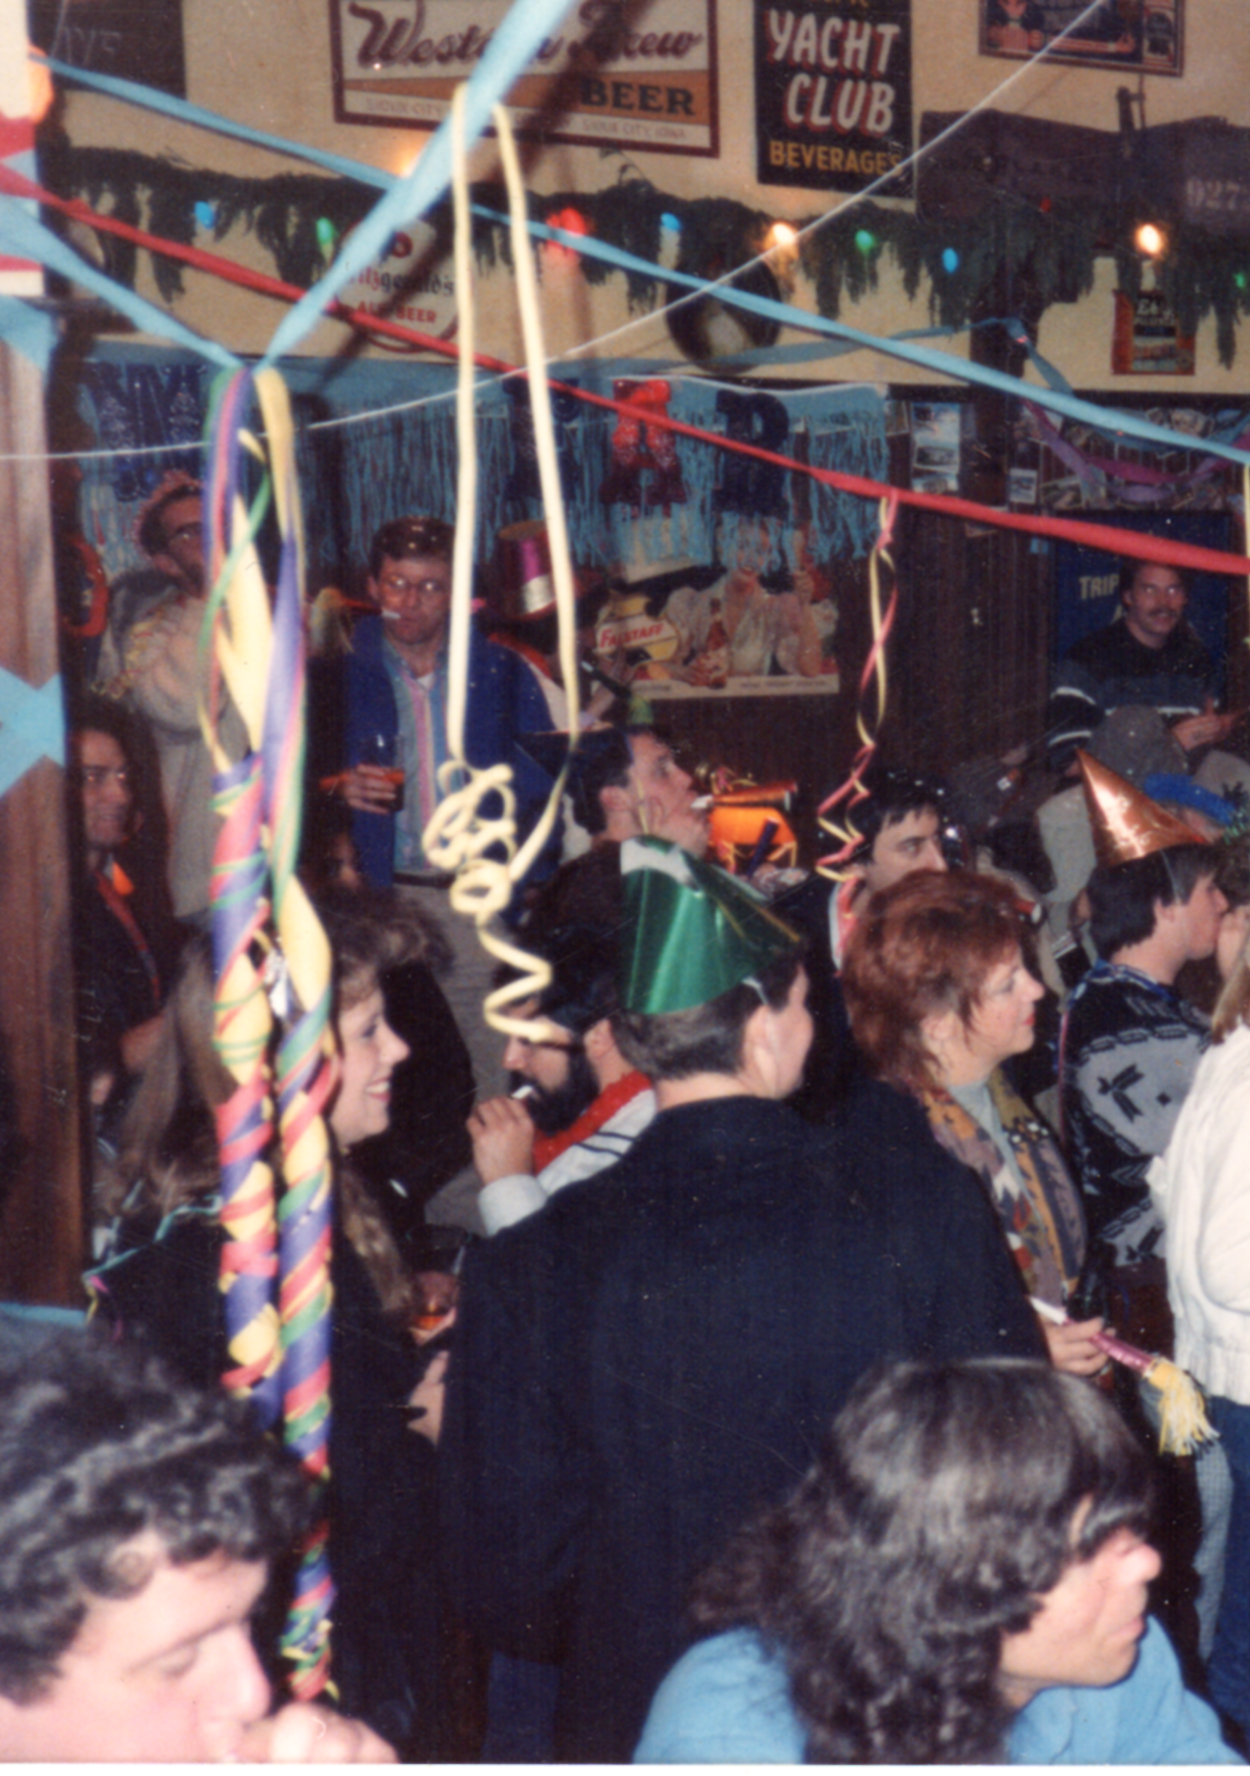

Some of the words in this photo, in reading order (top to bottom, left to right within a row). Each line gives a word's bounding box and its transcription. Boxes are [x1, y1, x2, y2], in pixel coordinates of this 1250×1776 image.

[766, 9, 900, 76] YACHT
[579, 79, 696, 117] BEER
[784, 73, 896, 137] CLUB
[769, 140, 904, 177] BEVERAGES
[395, 304, 437, 324] BEER
[600, 623, 665, 649] FALSTAFF
